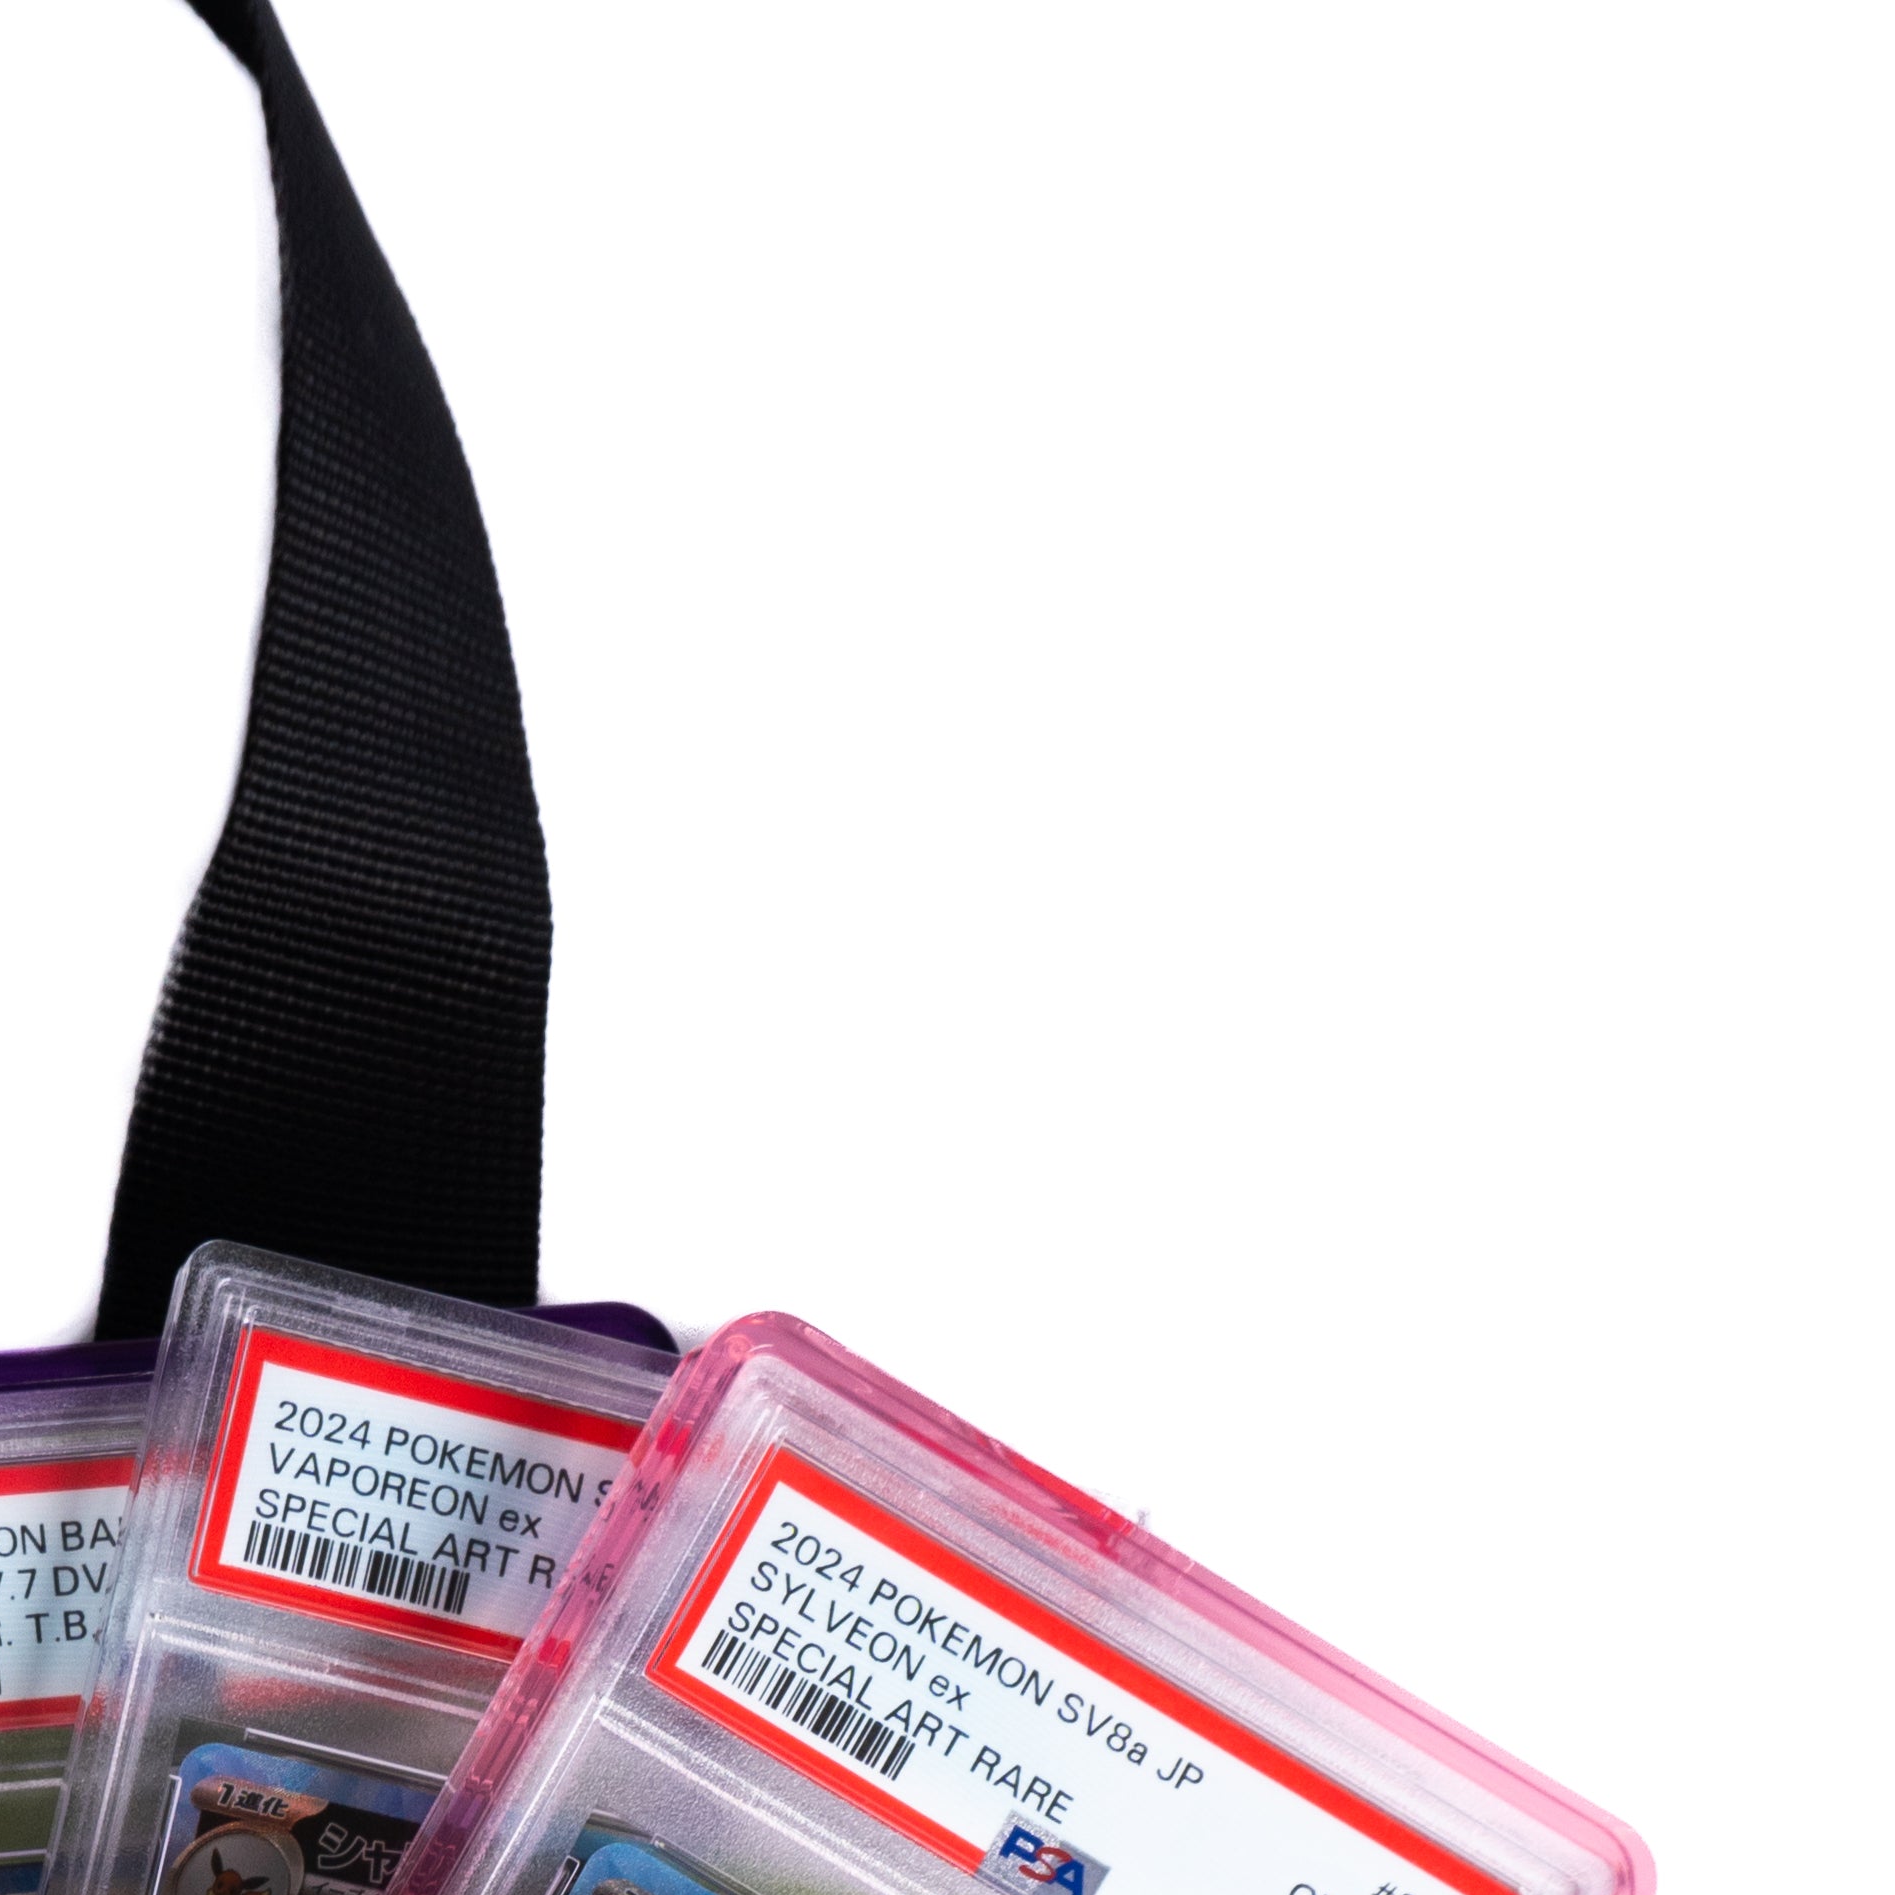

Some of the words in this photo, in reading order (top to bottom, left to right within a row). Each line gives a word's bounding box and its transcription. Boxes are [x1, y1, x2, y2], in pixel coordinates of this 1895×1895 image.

[269, 1442, 490, 1527] VAPOREON
[497, 1508, 543, 1540] ex
[274, 1400, 371, 1450] 2024
[383, 1426, 586, 1505] POKEMON
[255, 1488, 419, 1557] SPECIAL
[431, 1531, 521, 1579] ART
[750, 1560, 926, 1682] SYLVEON
[928, 1674, 970, 1711] ex
[770, 1521, 865, 1593] 2024
[868, 1578, 1054, 1707] POKEMON
[1056, 1692, 1148, 1766] SV8a
[1156, 1757, 1204, 1789] JP
[727, 1600, 873, 1711] SPECIAL
[883, 1698, 968, 1757] ART
[969, 1745, 1073, 1824] RARE
[217, 1783, 289, 1818] 1進化
